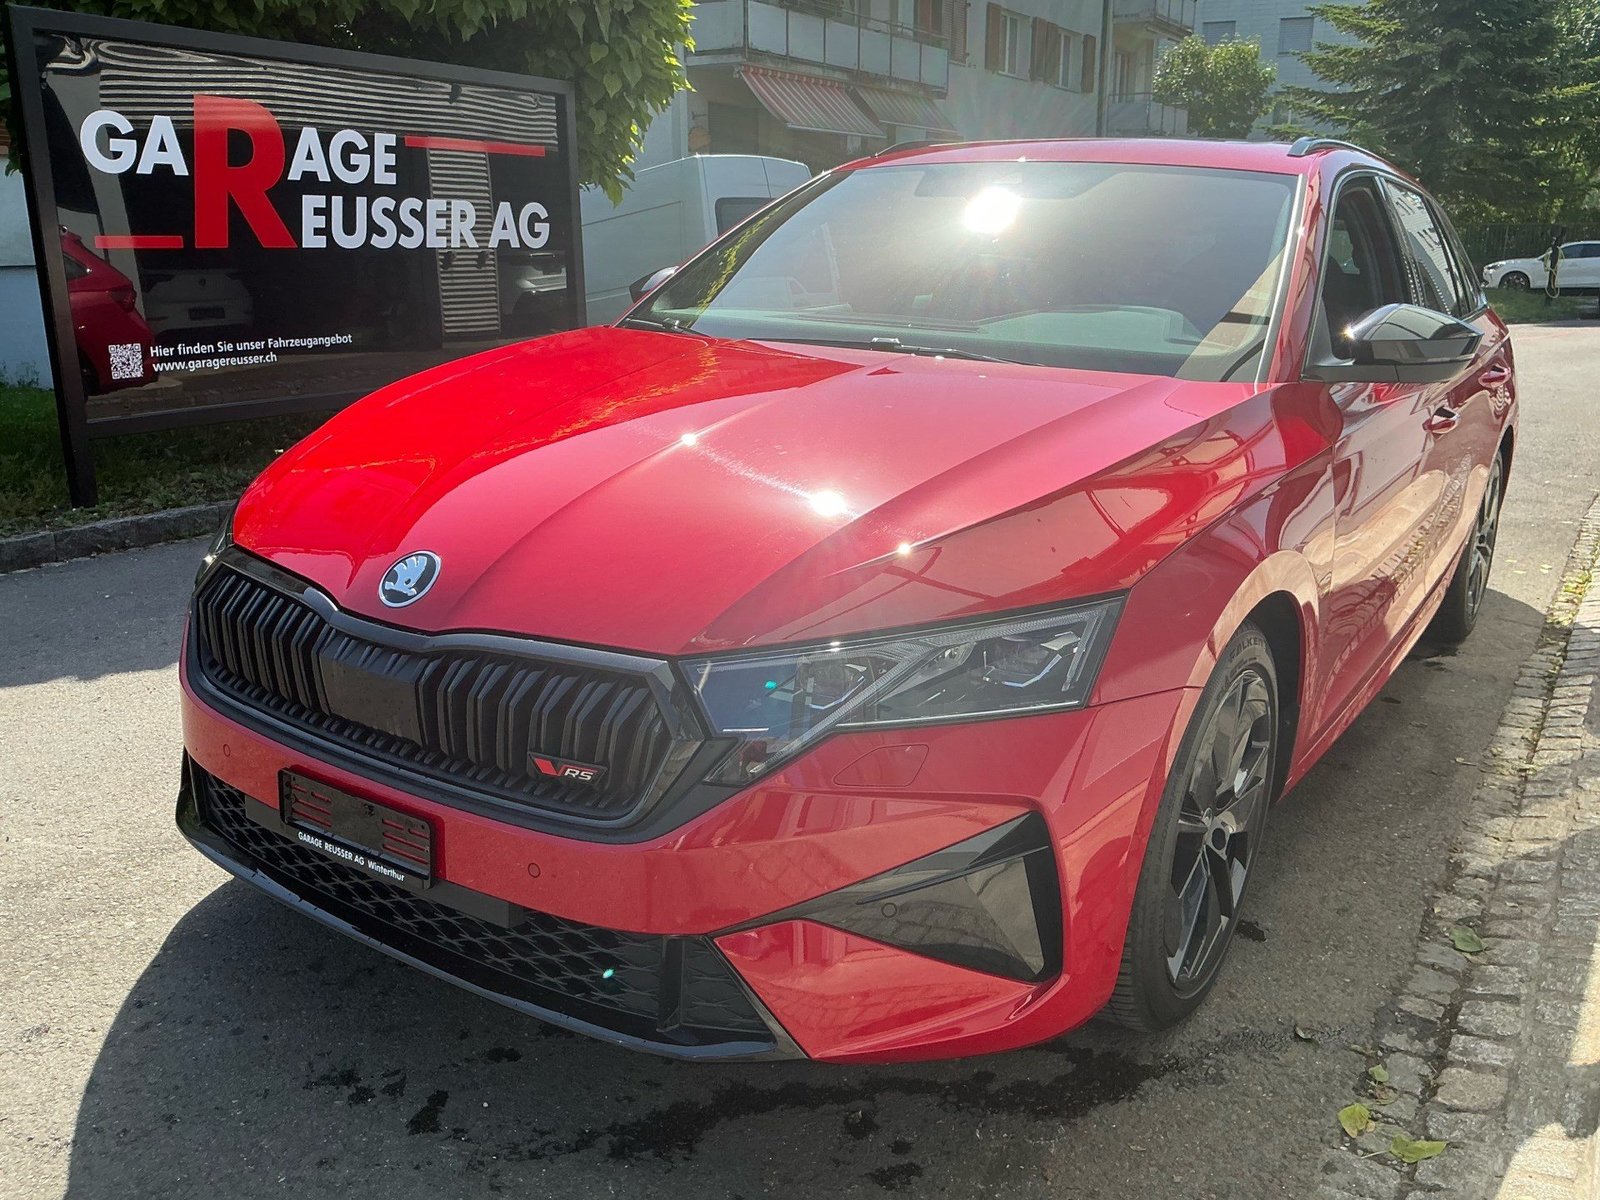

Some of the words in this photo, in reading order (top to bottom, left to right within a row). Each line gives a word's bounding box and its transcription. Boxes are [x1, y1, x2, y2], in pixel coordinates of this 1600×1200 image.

[80, 94, 398, 248] GARAGE
[488, 201, 550, 249] AG
[150, 345, 174, 357] Hier
[177, 342, 214, 355] finden
[217, 341, 233, 353] Sie
[236, 339, 265, 351] unser
[267, 334, 352, 349] Fahrzeugangebot
[153, 352, 277, 372] www.garagereusser.ch
[298, 831, 323, 848] GARAGE
[324, 842, 353, 861] REUSSER
[354, 855, 365, 866] AG
[367, 859, 405, 882] Winterthur
